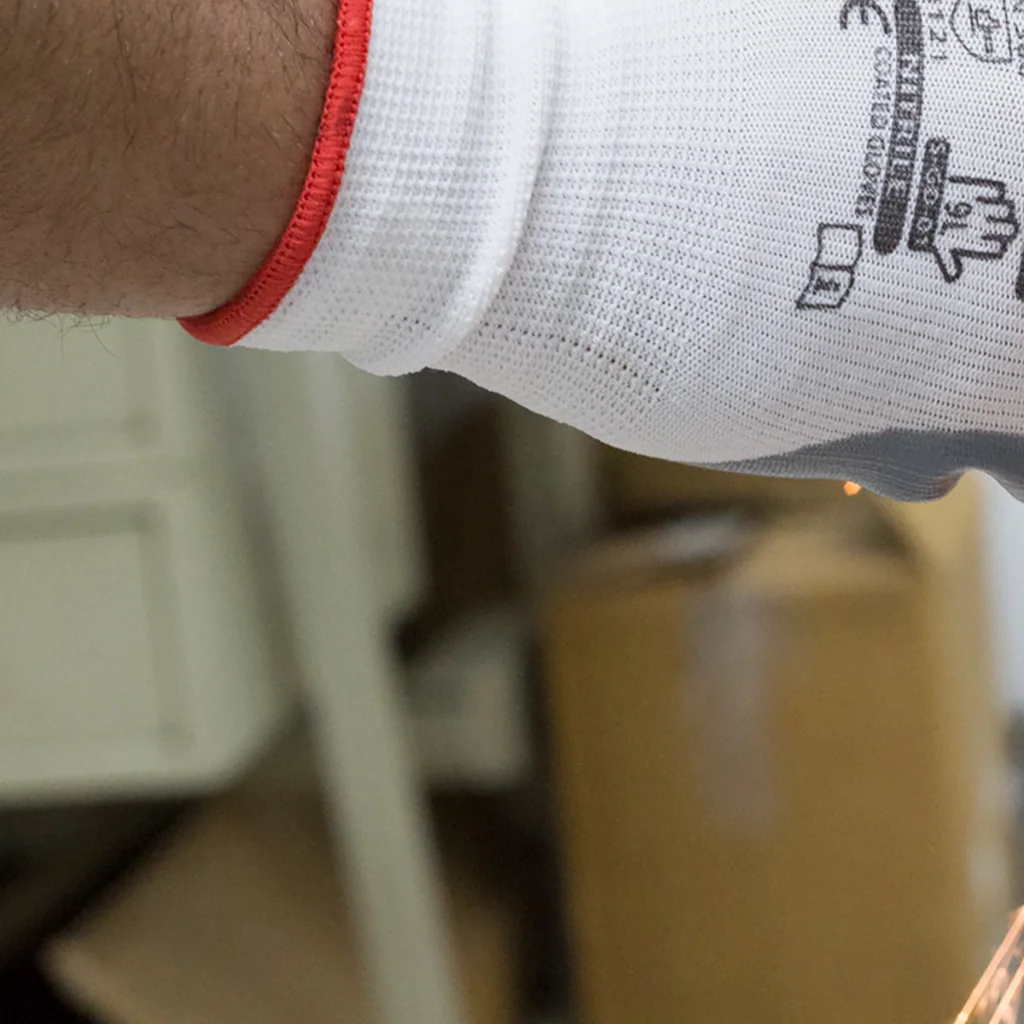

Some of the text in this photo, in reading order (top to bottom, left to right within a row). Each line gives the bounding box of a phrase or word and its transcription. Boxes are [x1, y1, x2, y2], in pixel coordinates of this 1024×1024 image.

[855, 47, 892, 218] COATED GLOVES
[889, 50, 922, 182] NITRILE
